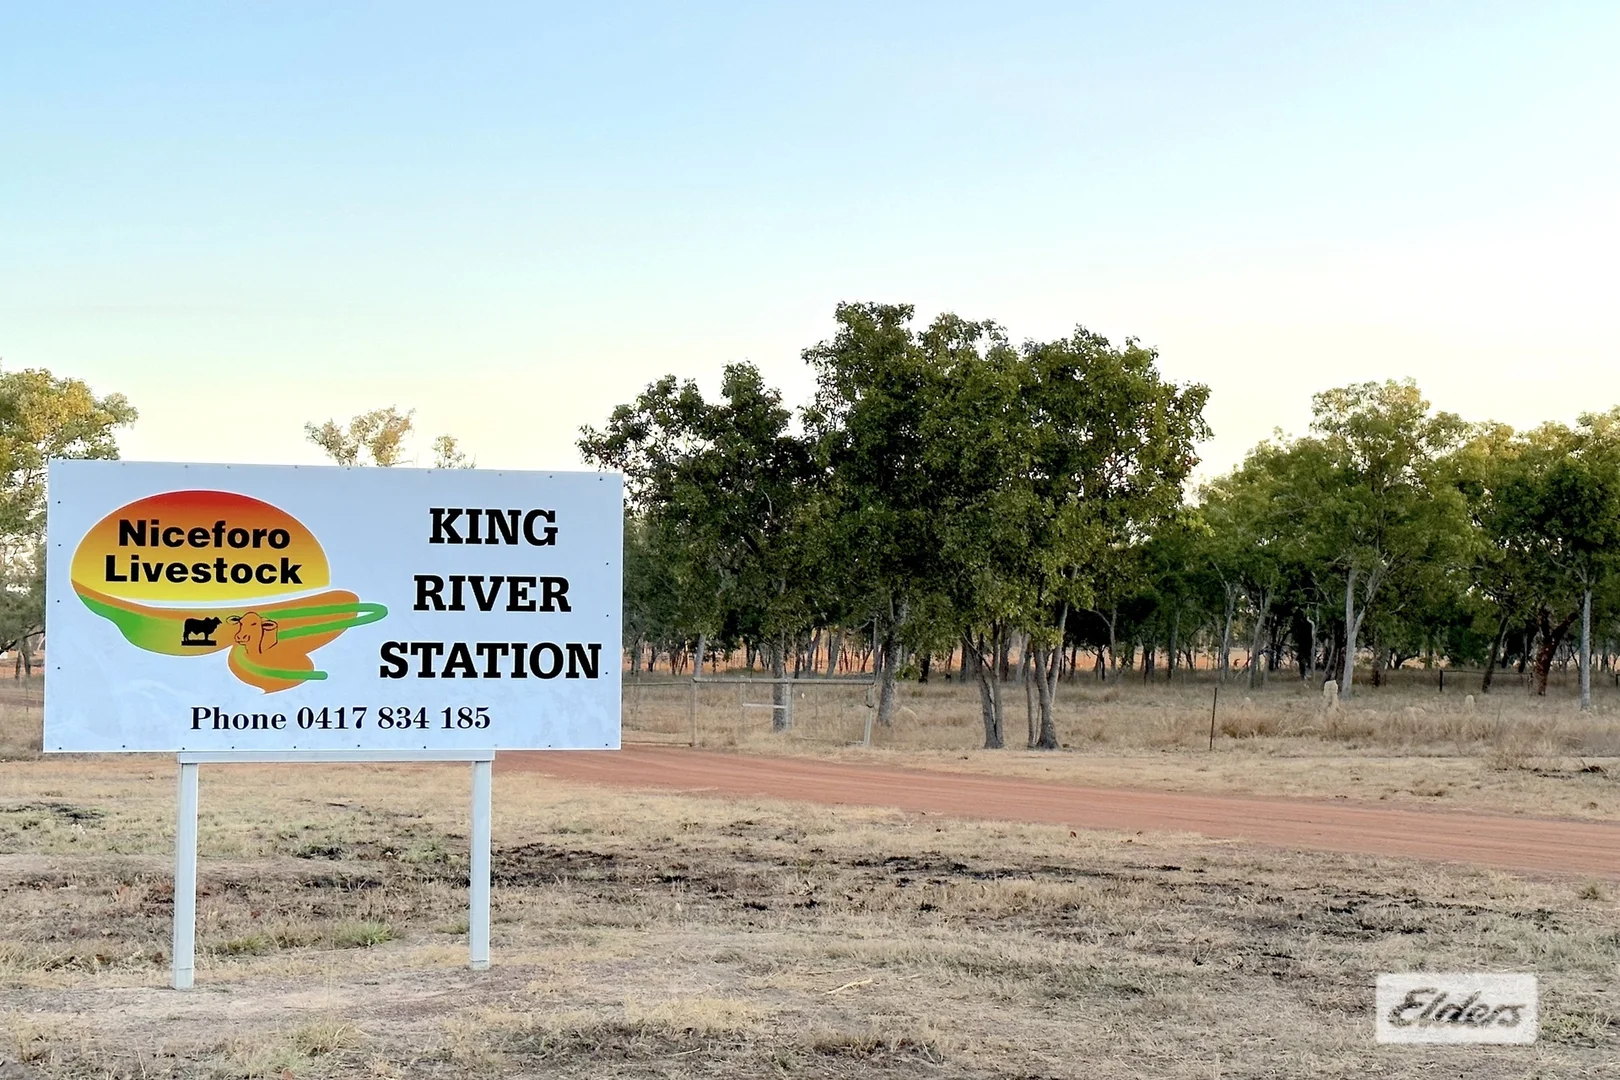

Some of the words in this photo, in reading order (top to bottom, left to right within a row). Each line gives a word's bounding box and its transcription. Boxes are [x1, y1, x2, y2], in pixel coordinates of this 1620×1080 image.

[119, 519, 290, 549] Niceforo
[429, 508, 558, 546] KING
[106, 555, 302, 584] Livestock
[414, 575, 571, 612] RIVER
[380, 642, 601, 679] STATION
[191, 707, 286, 729] Phone
[298, 707, 366, 729] 0417
[378, 707, 429, 729] 834
[442, 707, 490, 728] 185
